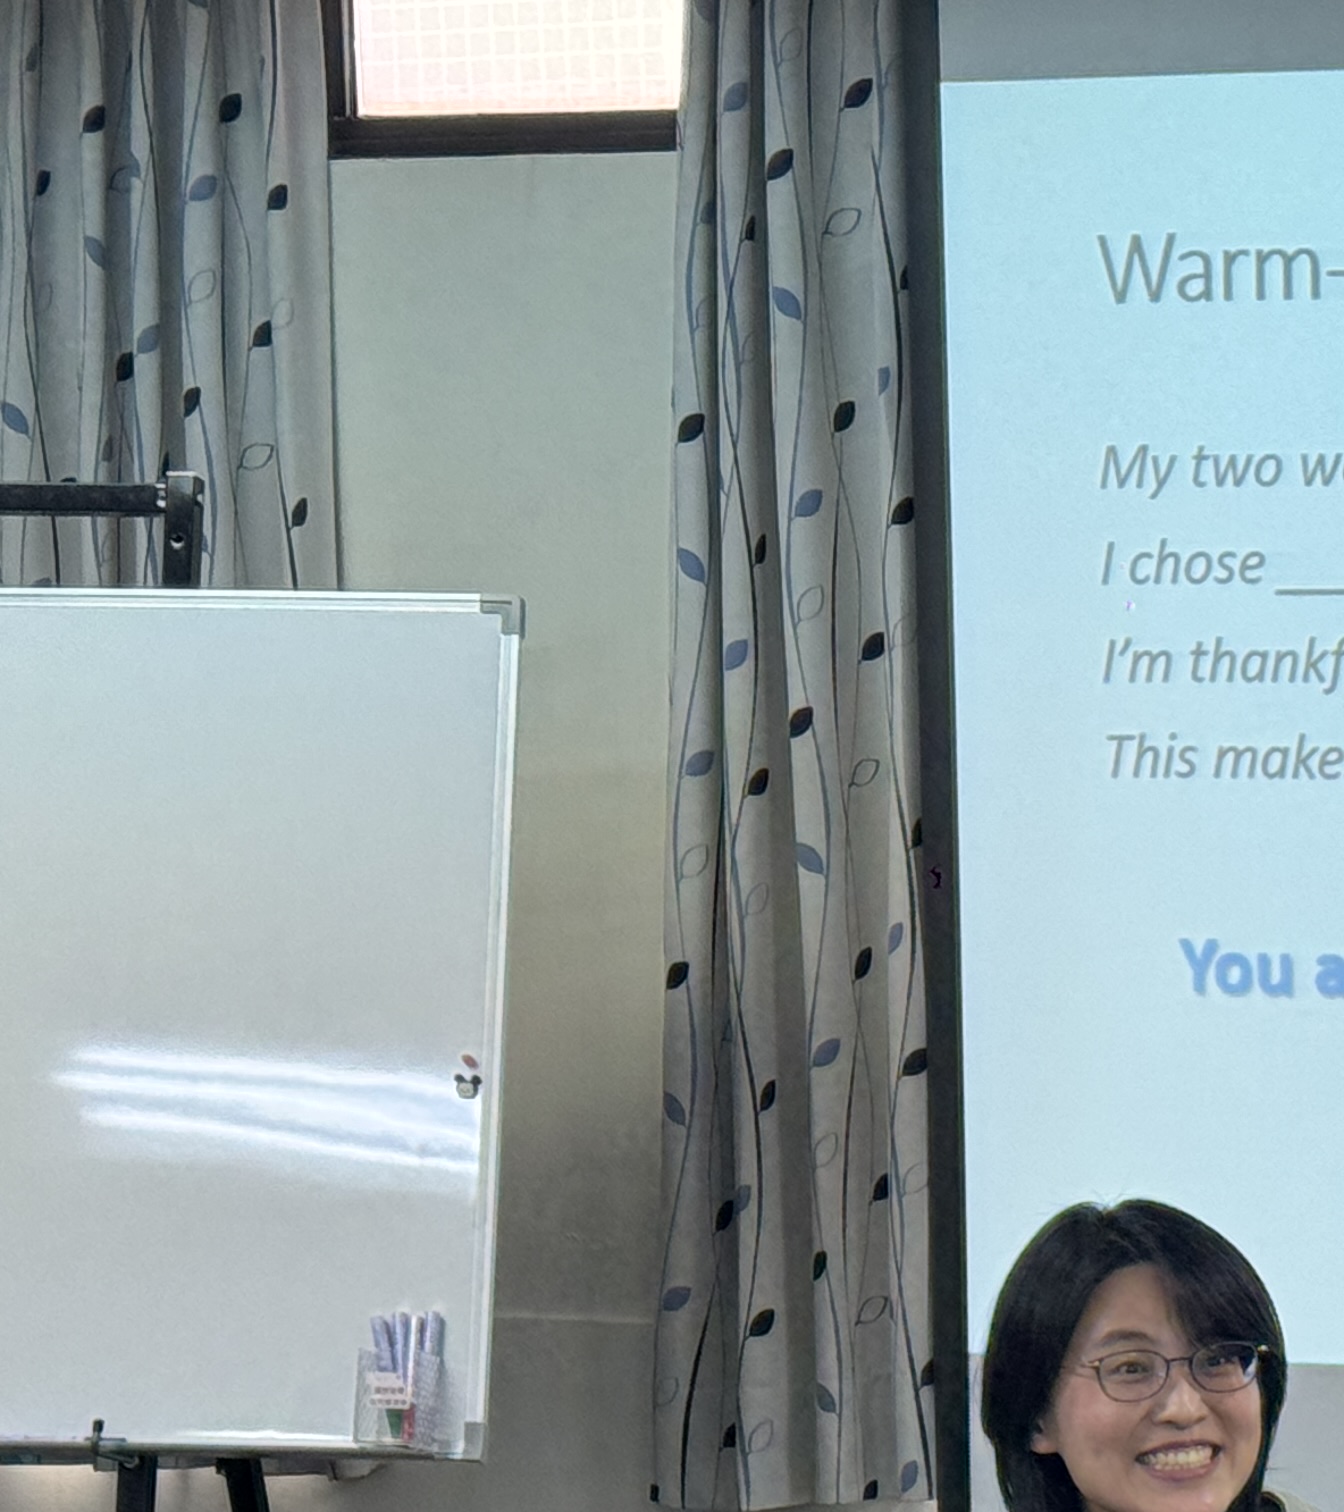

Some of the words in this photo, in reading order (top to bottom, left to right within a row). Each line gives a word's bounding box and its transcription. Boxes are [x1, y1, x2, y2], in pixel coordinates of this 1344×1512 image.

[1101, 444, 1179, 501] My
[1193, 446, 1285, 490] two
[1102, 542, 1116, 587] I
[1130, 538, 1268, 588] chose
[1104, 638, 1174, 686] I’m
[1107, 733, 1200, 782] This
[1180, 939, 1296, 1000] You
